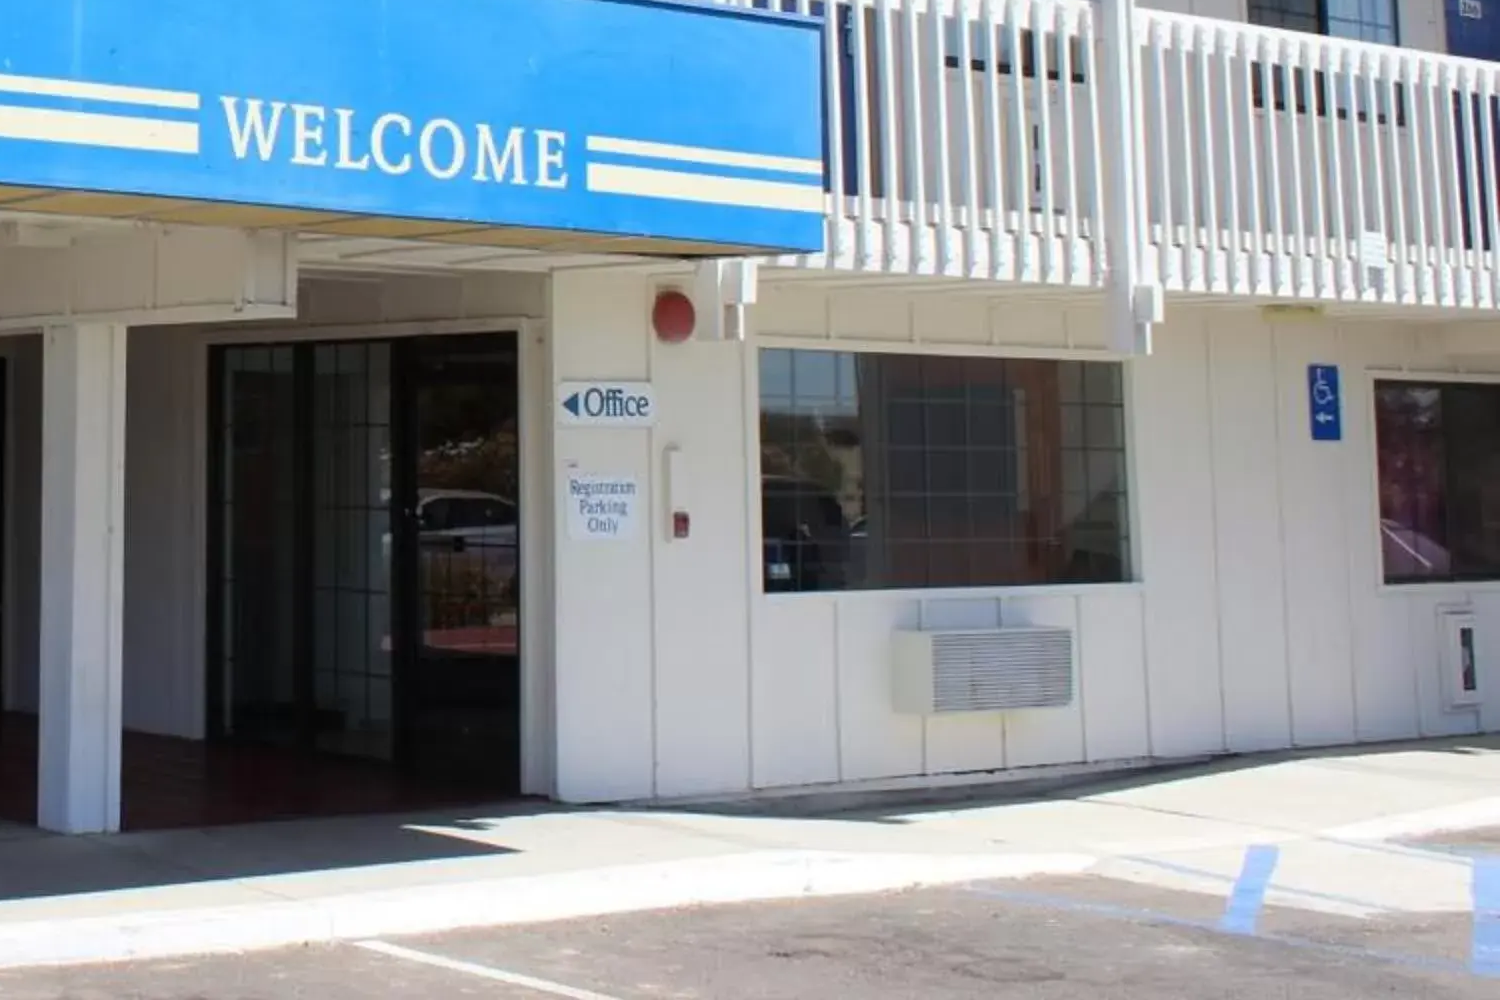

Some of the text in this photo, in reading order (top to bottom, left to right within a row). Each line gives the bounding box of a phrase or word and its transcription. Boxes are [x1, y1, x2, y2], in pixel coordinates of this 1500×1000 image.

[219, 95, 569, 189] WELCOME
[584, 387, 649, 417] Office
[570, 479, 636, 497] Registration
[579, 499, 628, 517] Parking
[587, 517, 618, 535] Only
